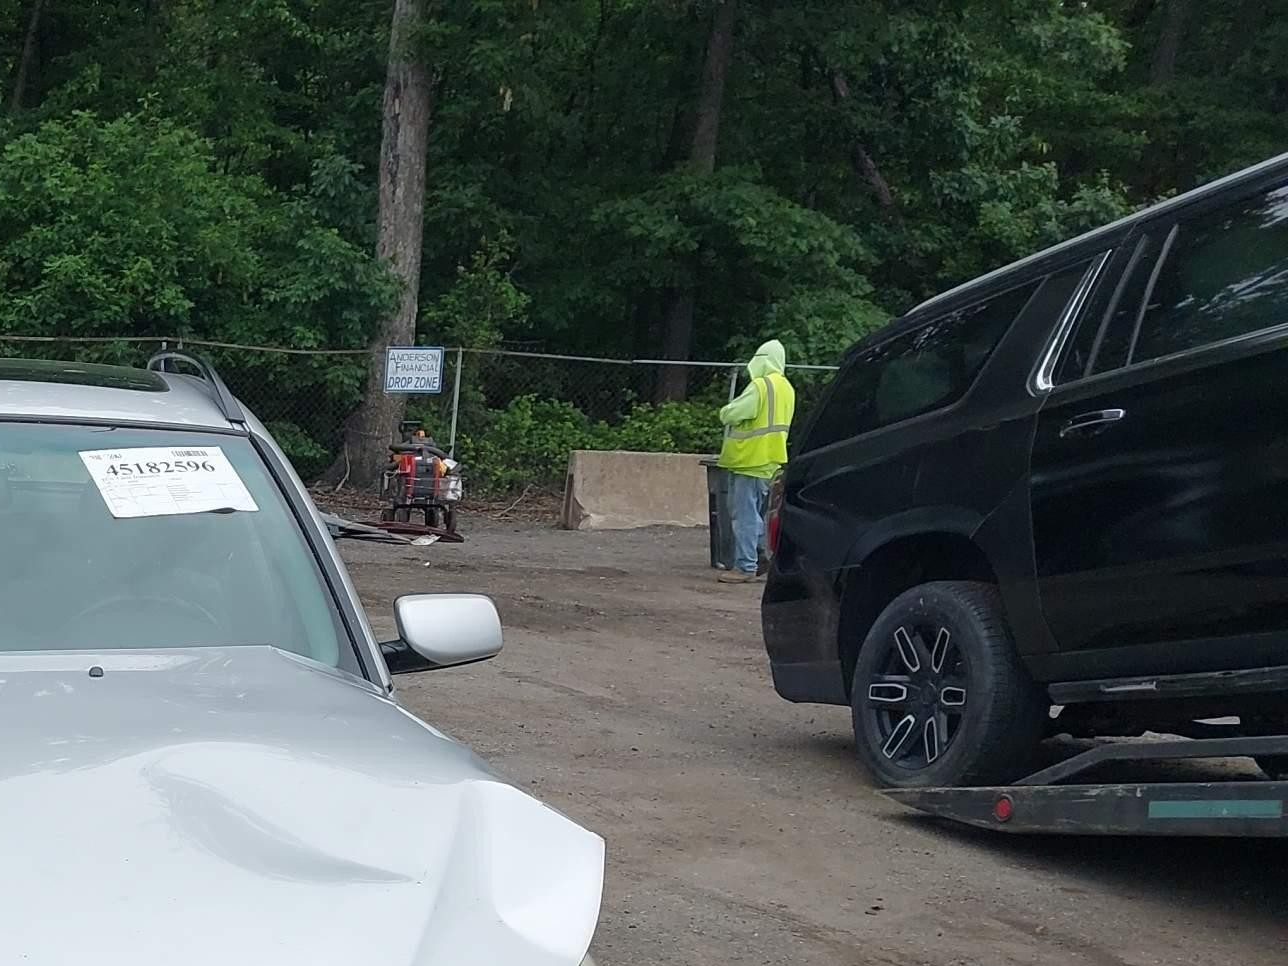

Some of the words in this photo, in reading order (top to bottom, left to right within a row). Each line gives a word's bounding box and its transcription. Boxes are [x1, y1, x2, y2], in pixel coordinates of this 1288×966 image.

[390, 351, 439, 362] ANDERSON
[395, 362, 438, 374] FINANCIAL
[388, 376, 412, 388] DROP
[414, 376, 438, 388] ZONE
[107, 460, 215, 476] 45182596
